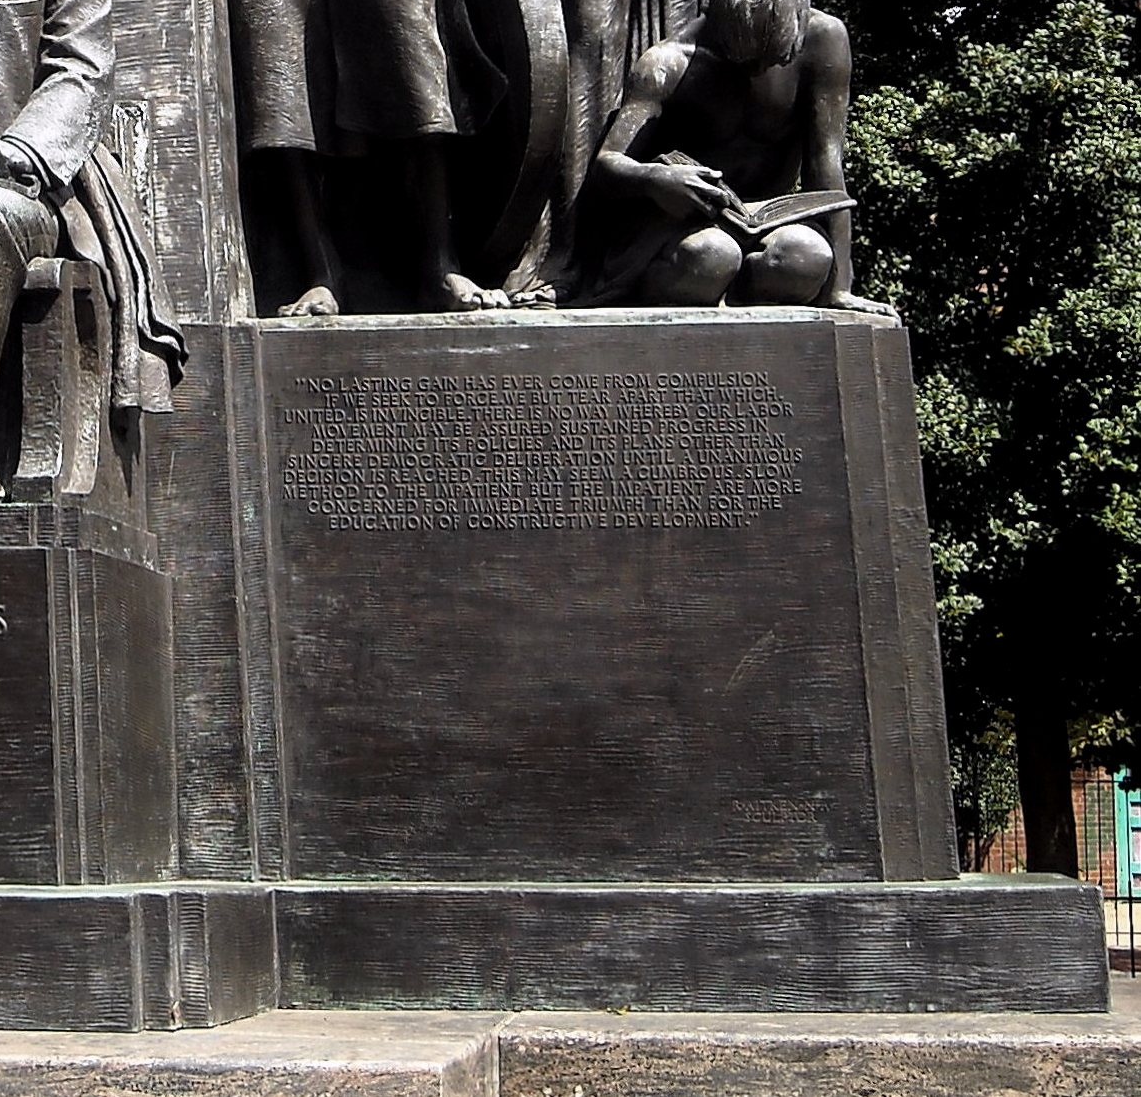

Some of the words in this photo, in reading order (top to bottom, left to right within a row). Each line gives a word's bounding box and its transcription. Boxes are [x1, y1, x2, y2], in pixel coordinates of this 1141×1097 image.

[339, 377, 411, 392] LASTING
[418, 376, 460, 391] GAIN
[464, 375, 496, 390] HAS
[502, 375, 543, 390] EVER
[550, 374, 599, 389] COME
[604, 373, 651, 388] FROM
[657, 372, 768, 387] COMPULSION
[324, 393, 339, 408] IF
[343, 393, 365, 407] WE
[372, 392, 410, 407] SEEK
[415, 392, 439, 406] TO
[504, 390, 526, 405] WE
[531, 390, 563, 405] BUT
[568, 389, 611, 404] TEAR
[619, 389, 666, 403] APART
[673, 388, 714, 403] THAT
[353, 408, 368, 423] IS
[472, 406, 524, 421] THERE
[529, 405, 543, 420] IS
[548, 405, 573, 420] NO
[577, 405, 610, 420] WAY
[617, 404, 691, 419] WHEREBY
[696, 403, 732, 418] OUR
[735, 403, 794, 417] LABOR
[312, 423, 407, 437] MOVEMENT
[412, 422, 448, 437] MAY
[454, 422, 472, 436] BE
[479, 421, 552, 436] ASSURED
[560, 420, 653, 434] SUSTAINED
[659, 419, 746, 433] PROGRESS
[751, 418, 768, 433] IN
[312, 438, 427, 452] DETERMINING
[434, 437, 460, 451] ITS
[467, 437, 543, 451] POLICIES
[550, 436, 584, 451] AND
[591, 436, 616, 450] ITS
[622, 435, 674, 450] PLANS
[679, 435, 735, 449] OTHER
[739, 434, 785, 449] THAN
[288, 454, 362, 468] SINCERE
[368, 452, 486, 467] DEMOCRATIC
[493, 451, 617, 465] DELIBERATION
[622, 450, 675, 464] UNTIL
[682, 450, 693, 464] A
[697, 449, 803, 463] UNANIMOUS
[283, 469, 365, 483] DECISION
[370, 468, 385, 483] IS
[481, 467, 520, 482] THIS
[526, 467, 563, 481] MAY
[570, 466, 615, 481] SEEM
[620, 466, 632, 480] A
[745, 464, 795, 479] SLOW
[283, 484, 359, 499] METHOD
[365, 484, 389, 498] TO
[395, 483, 427, 498] THE
[434, 483, 523, 498] IMPATIENT
[530, 482, 563, 497] BUT
[570, 482, 603, 496] THE
[610, 481, 706, 496] IMPATIENT
[712, 481, 745, 495] ARE
[752, 480, 802, 495] MORE
[308, 499, 418, 514] CONCERNED
[424, 499, 457, 513] FOR
[464, 498, 563, 512] IMMEDIATE
[570, 497, 646, 512] TRIUMPH
[652, 497, 701, 511] THAN
[709, 496, 744, 510] FOR
[747, 496, 782, 510] THE
[329, 515, 434, 530] EDUCATION
[438, 514, 460, 530] OF
[467, 514, 608, 529] CONSTRUCTIVE
